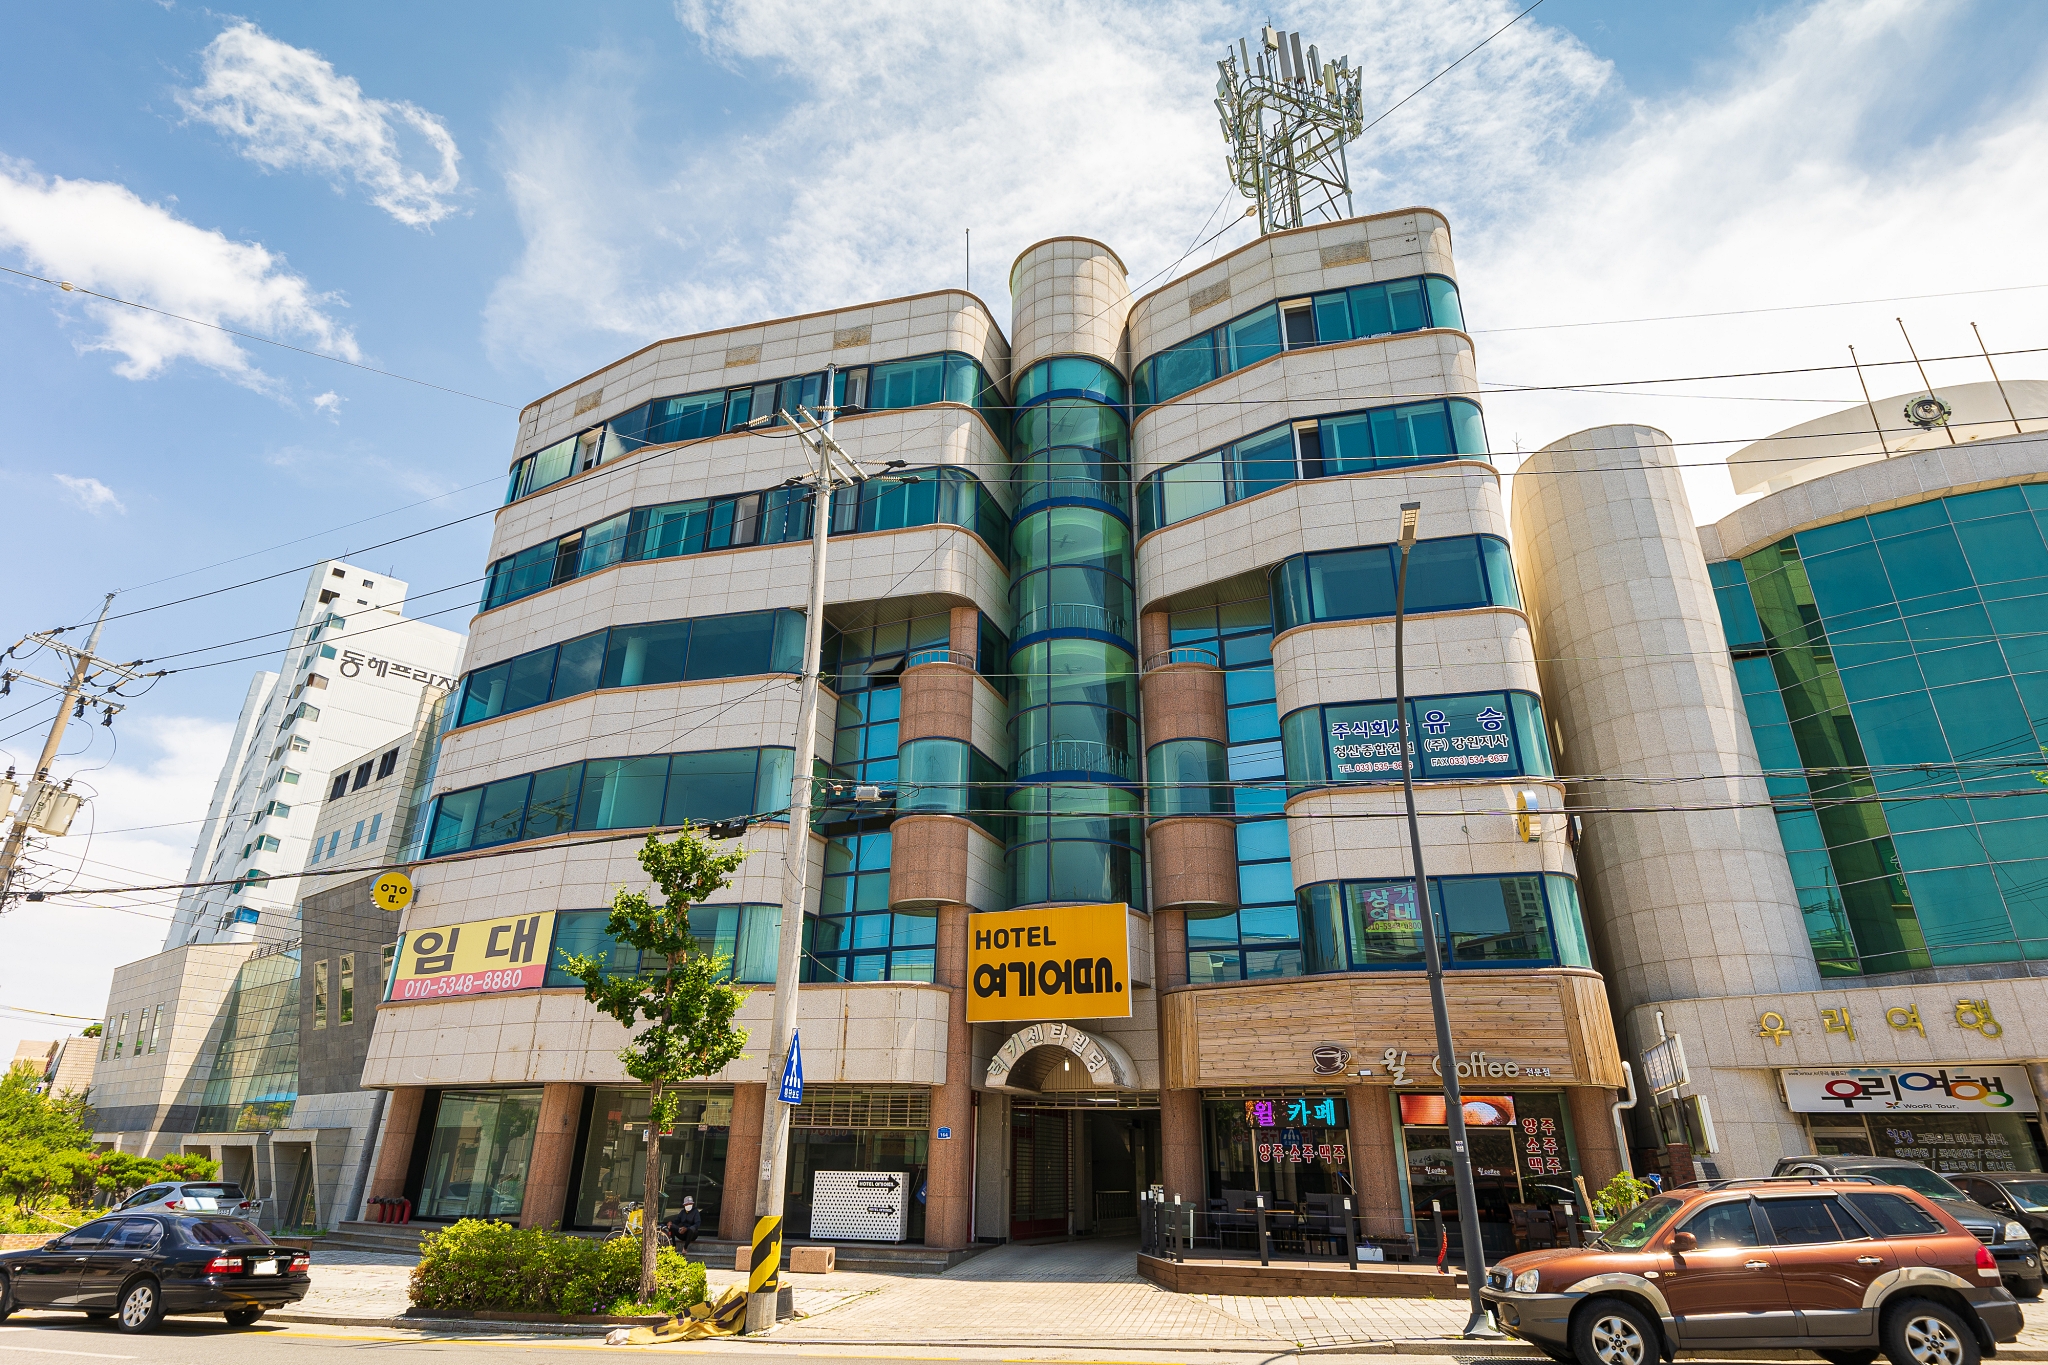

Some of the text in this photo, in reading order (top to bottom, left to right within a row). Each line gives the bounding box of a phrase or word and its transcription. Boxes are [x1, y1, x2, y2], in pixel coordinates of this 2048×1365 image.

[1451, 733, 1509, 750] 강원지사
[1374, 759, 1414, 772] 535-366
[1431, 757, 1450, 767] FAX
[1367, 885, 1416, 908] 상가
[975, 926, 1057, 951] HOTEL
[404, 969, 523, 998] 010-5348-8880
[1821, 1069, 2015, 1108] 우리여행
[1287, 1098, 1337, 1127] 카페
[1521, 1117, 1556, 1136] 양주
[1525, 1137, 1559, 1156] 소주
[1527, 1157, 1562, 1176] 맥주
